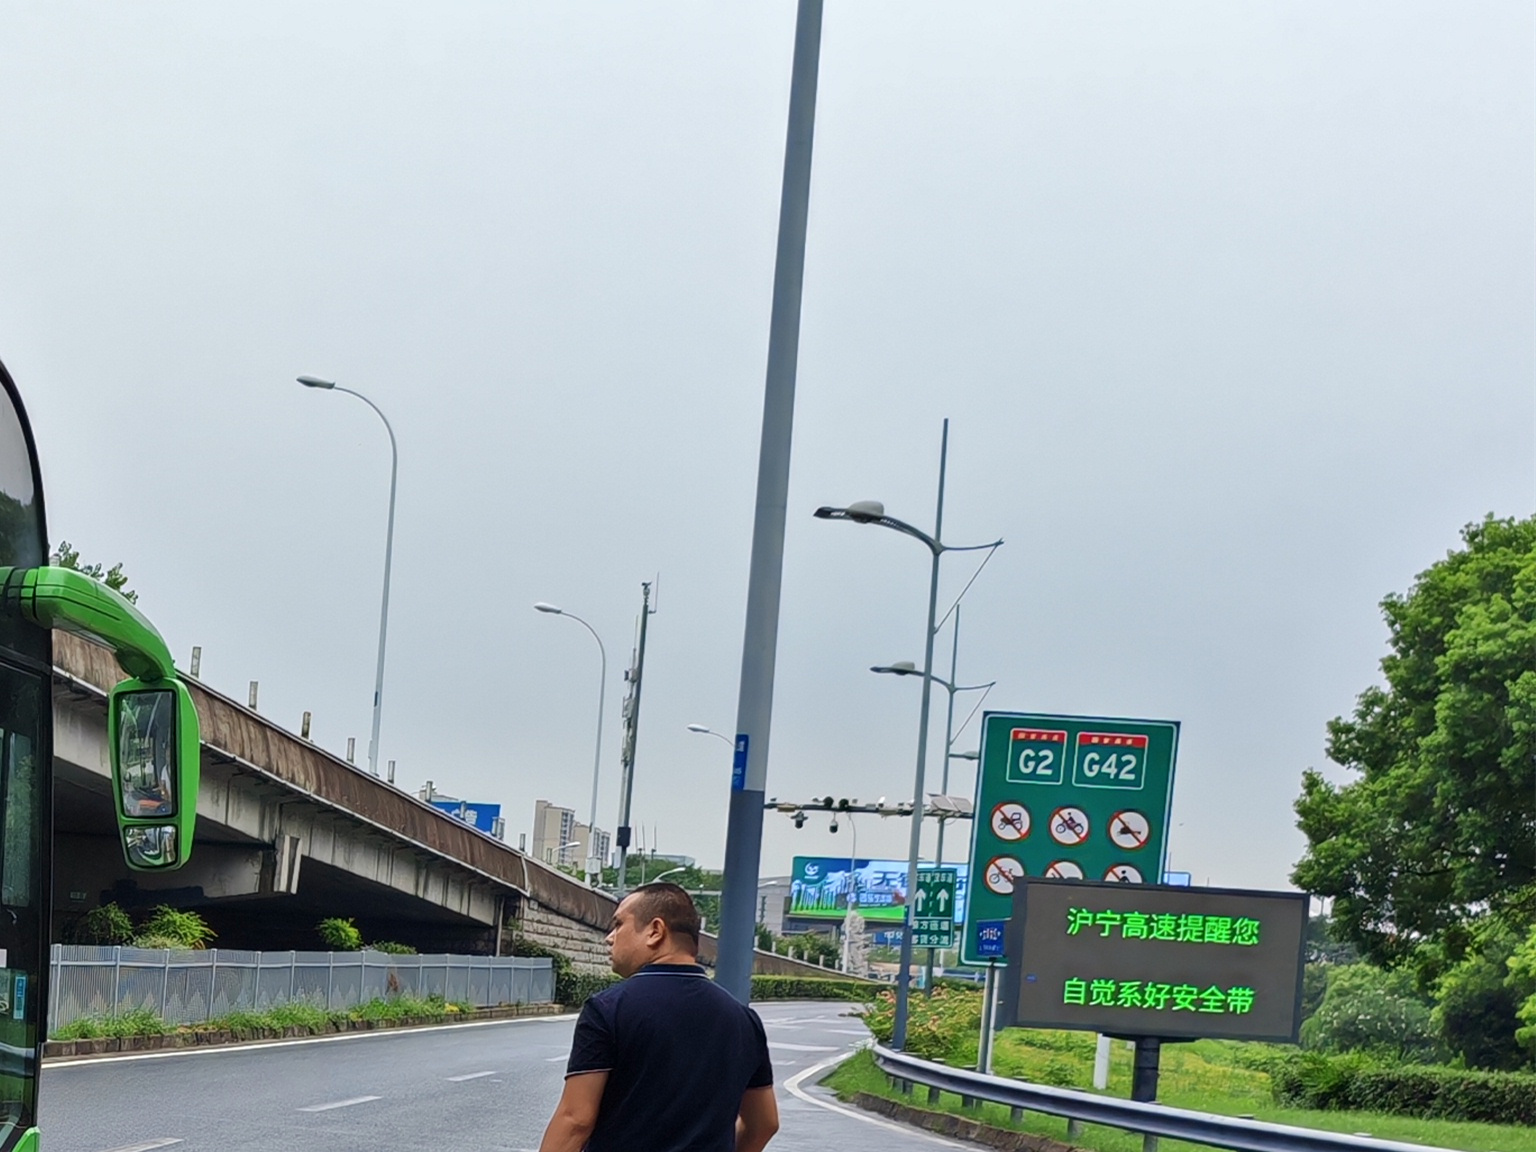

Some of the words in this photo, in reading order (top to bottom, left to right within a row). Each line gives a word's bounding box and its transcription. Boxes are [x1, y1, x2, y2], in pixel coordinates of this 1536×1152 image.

[1018, 748, 1054, 776] G2
[1082, 752, 1137, 780] G42
[1066, 907, 1260, 946] 沪宁高速提醒您
[1063, 976, 1256, 1015] 自觉系好安全带
